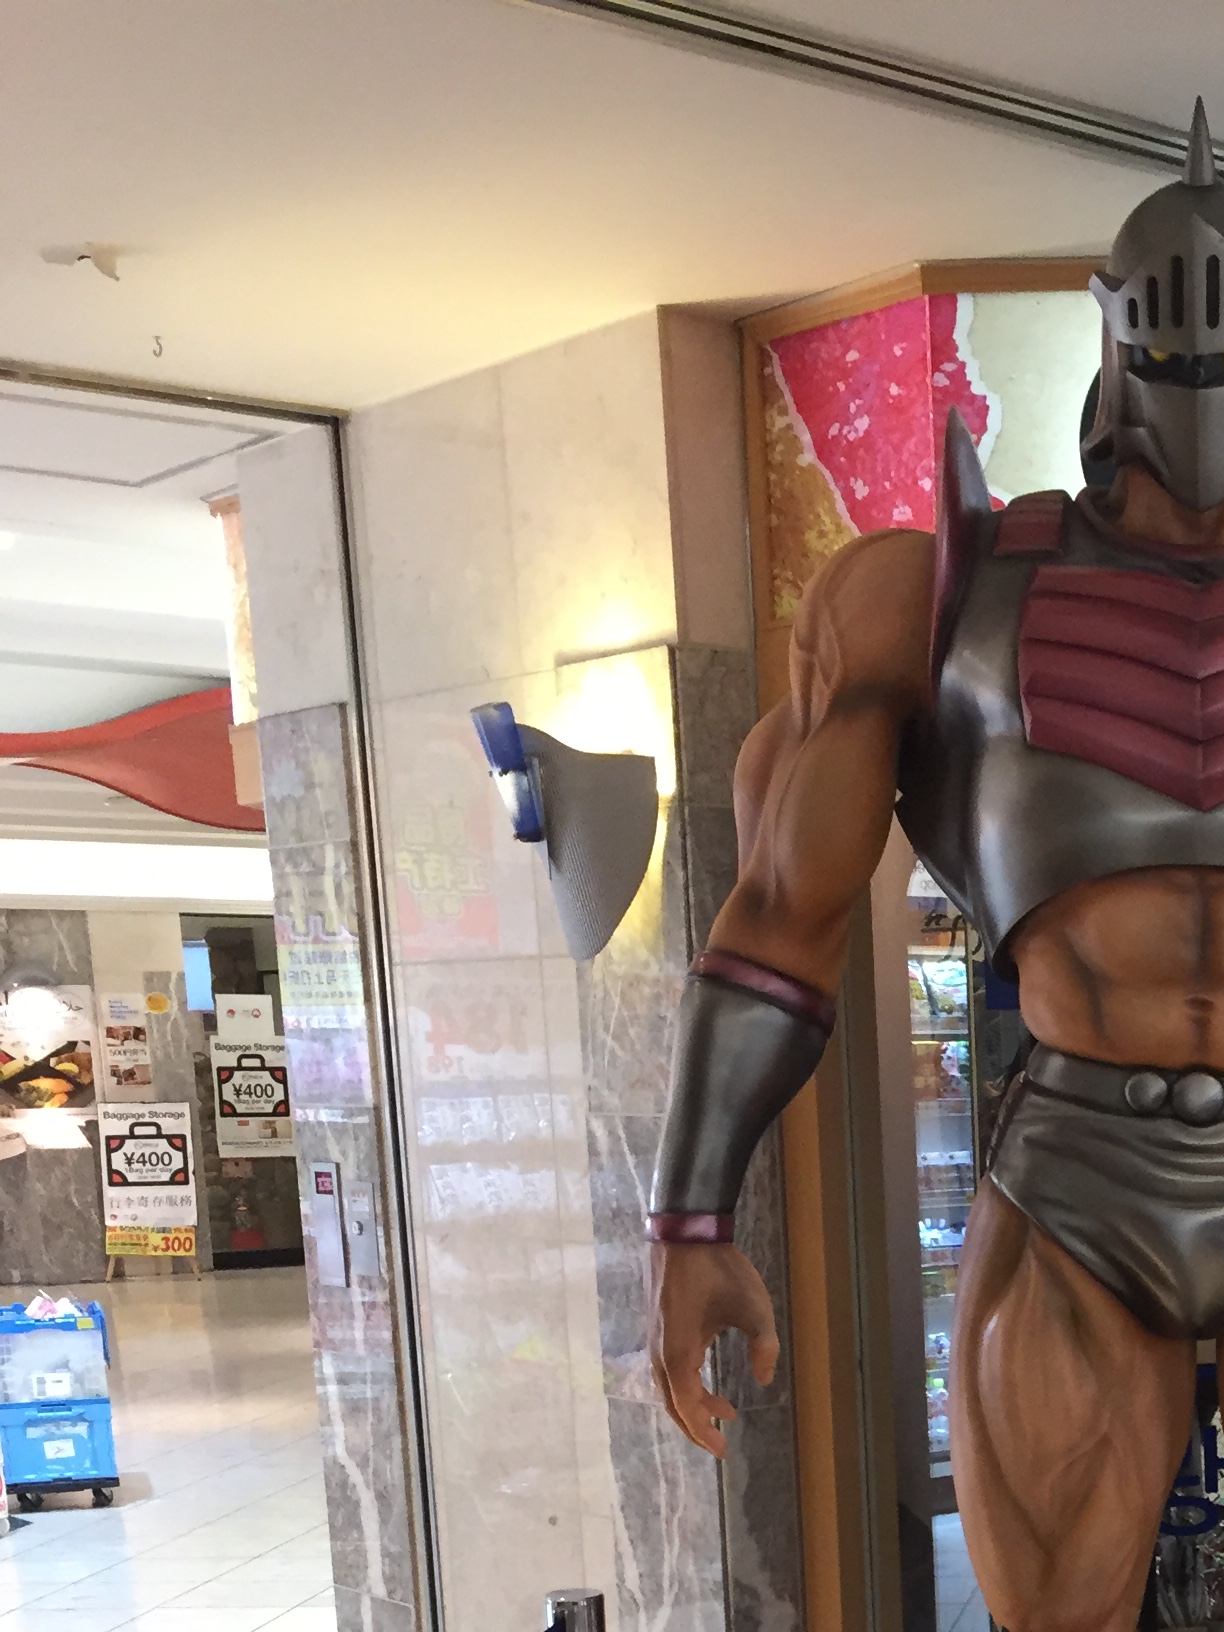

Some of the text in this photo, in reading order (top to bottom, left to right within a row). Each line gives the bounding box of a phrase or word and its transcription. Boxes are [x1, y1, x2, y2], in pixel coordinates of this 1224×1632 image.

[213, 1042, 286, 1054] Baggage Storage
[232, 1082, 275, 1099] ¥400
[103, 1110, 186, 1121] Baggage Storage
[122, 1151, 173, 1168] ¥400
[152, 1235, 194, 1253] ¥300
